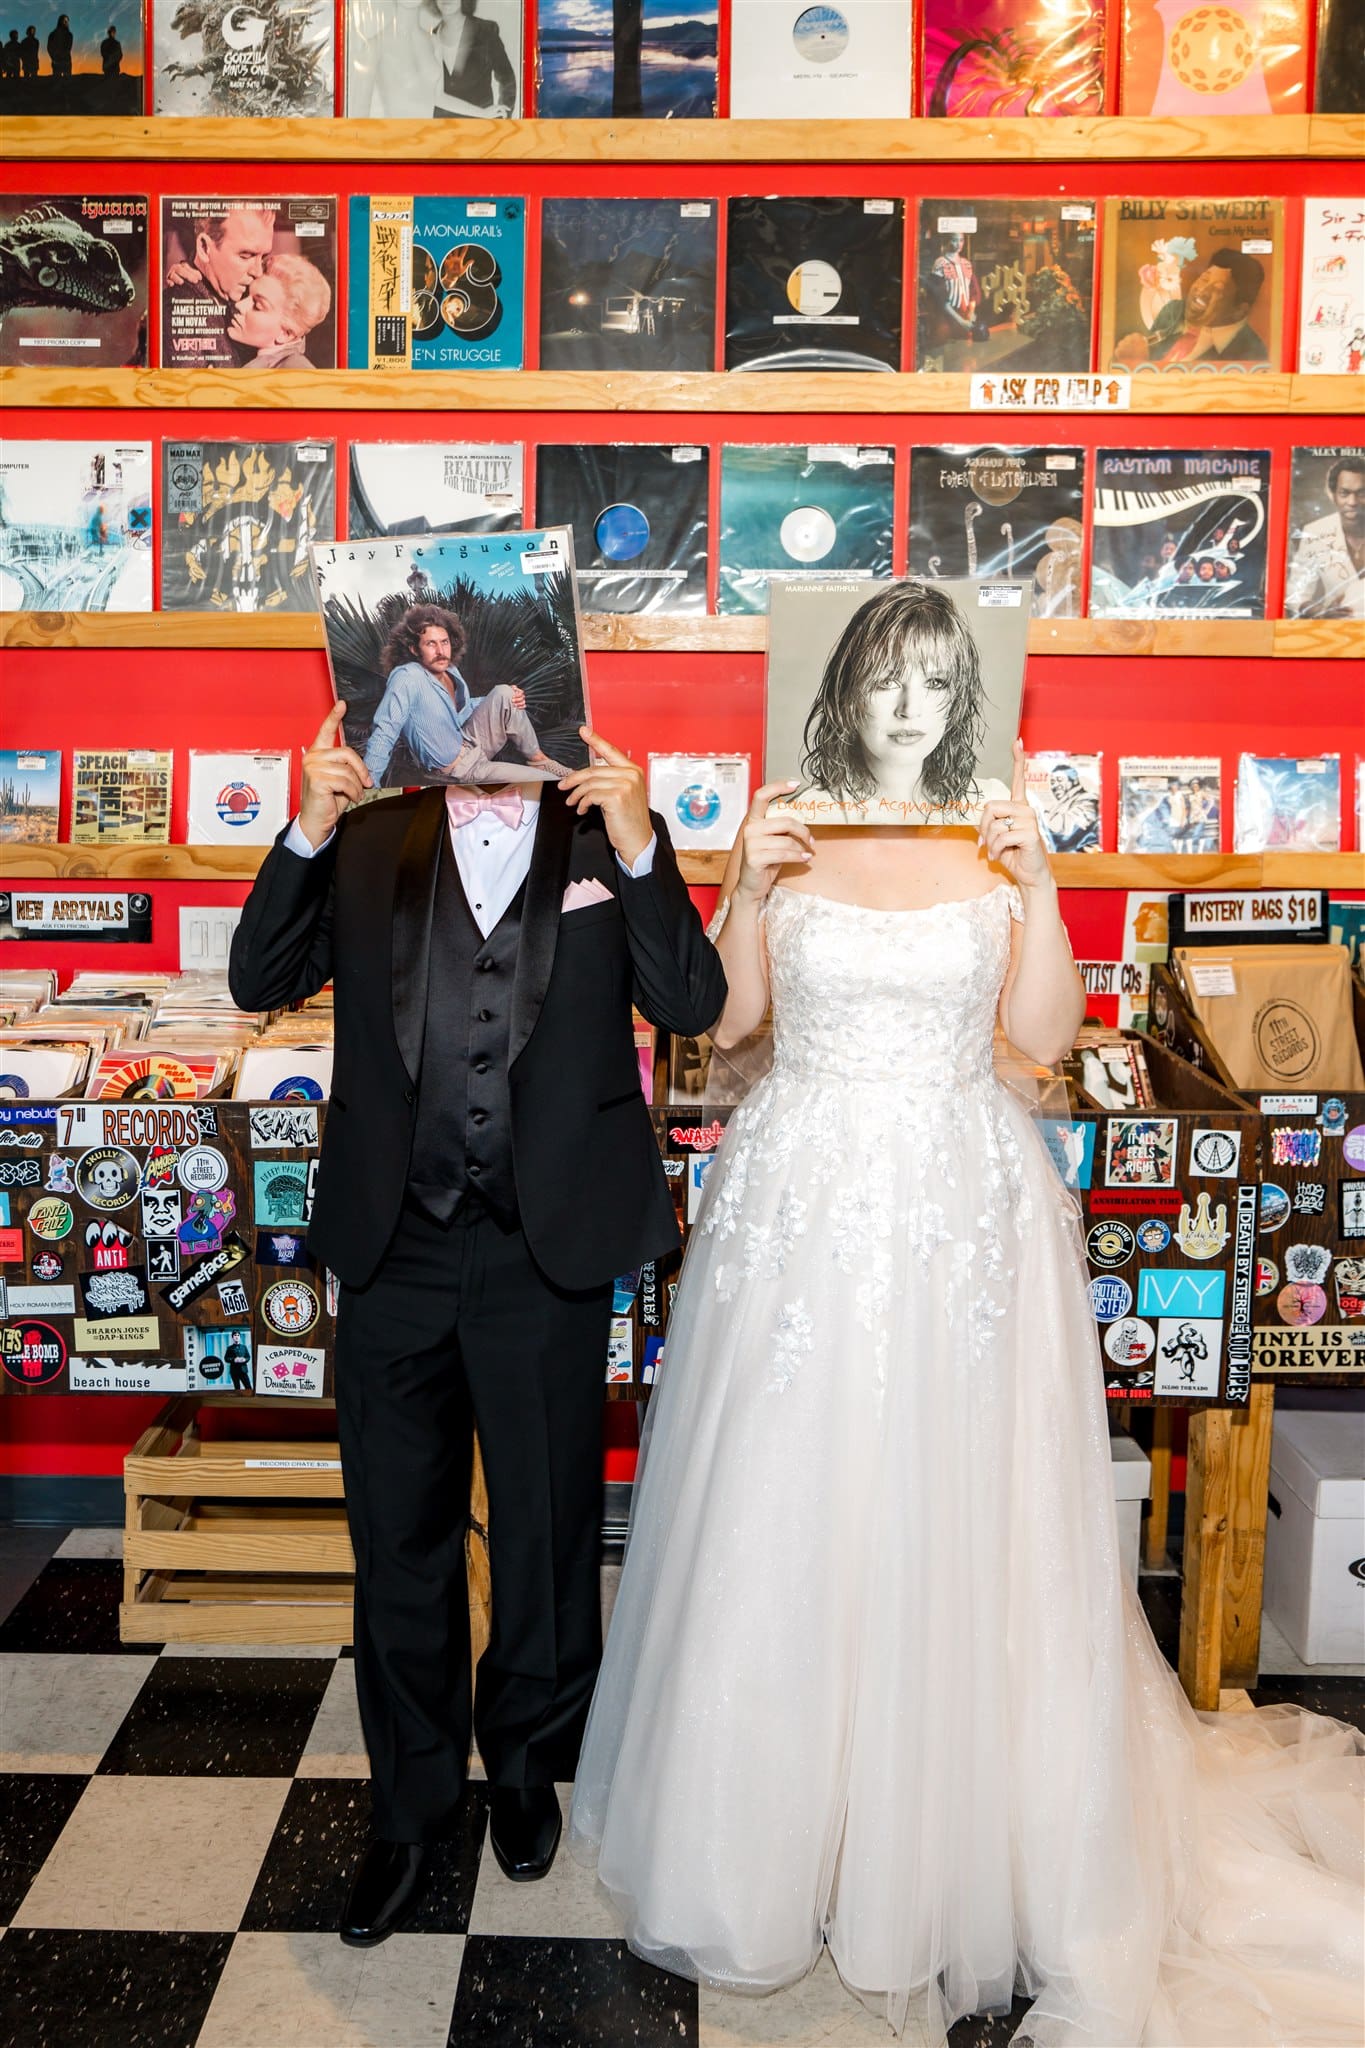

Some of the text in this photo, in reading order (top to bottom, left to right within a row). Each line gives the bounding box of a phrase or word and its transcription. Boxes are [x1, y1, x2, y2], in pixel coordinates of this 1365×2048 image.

[223, 51, 268, 65] GODZILLA
[222, 63, 270, 77] MINUS ONE
[82, 197, 147, 218] iguana
[171, 202, 188, 210] FROM
[188, 202, 199, 210] THE
[200, 202, 221, 210] MOTION
[222, 202, 244, 210] PICTURE
[1119, 200, 1169, 221] BILLY
[1320, 209, 1346, 227] Sir
[423, 224, 503, 237] MONAURAIL's
[1232, 225, 1248, 238] My
[171, 305, 227, 316] JAMES STEWART
[171, 316, 208, 327] KIM NOVAK
[172, 338, 217, 351] VERTIGO
[440, 348, 501, 362] STRUGGLE
[1000, 378, 1102, 405] ASK FOR HELP
[170, 449, 201, 457] MAD MAX
[1312, 447, 1337, 457] ALEX
[443, 460, 513, 483] REALITY
[1103, 457, 1260, 475] RHYTHM MACHINE
[443, 476, 511, 495] FOR THE PEOPLE
[939, 470, 976, 488] FOREST
[326, 538, 560, 565] Jay Ferguson
[785, 584, 860, 593] MARIANNE FAITHFULL
[78, 756, 127, 769] SPEACH
[77, 771, 168, 785] IMPEDIMENTS
[776, 798, 869, 821] Dangerous
[16, 899, 124, 921] NEW ARRIVALS
[1189, 895, 1318, 924] MYSTERY BAGS $10
[1121, 963, 1143, 994] CDs
[1269, 1027, 1300, 1052] STREET
[1271, 1037, 1309, 1067] RECORDS
[60, 1107, 200, 1146] 7" RECORDS
[1127, 1132, 1156, 1145] IT ALL
[85, 1150, 128, 1168] SKULLY'Z
[1127, 1146, 1156, 1159] FEELS
[145, 1153, 180, 1182] AMOEBA
[192, 1166, 213, 1174] STREET
[196, 1158, 210, 1167] 11TH
[1126, 1160, 1156, 1174] RIGHT
[190, 1173, 217, 1181] RECORDS
[90, 1192, 132, 1207] RECORDZ
[31, 1204, 69, 1220] SANTA
[36, 1217, 68, 1233] CRUZ
[1093, 1223, 1132, 1243] BAD TIMING
[1155, 1222, 1168, 1233] BOY
[96, 1250, 126, 1267] ANTI-
[1234, 1212, 1253, 1324] DEATH BY STEREO
[168, 1251, 230, 1308] gameface
[1091, 1283, 1128, 1299] BROTHER
[1143, 1275, 1220, 1311] IVY
[86, 1326, 150, 1335] SHARON JONES
[1252, 1331, 1343, 1347] VINYL IS
[32, 1343, 59, 1359] BOMB
[269, 1349, 303, 1360] CRAPPED
[302, 1353, 318, 1364] OUT
[1251, 1349, 1365, 1367] FOREVER
[1226, 1324, 1250, 1401] THE LOUD PIPES
[74, 1376, 151, 1388] beach house
[264, 1376, 316, 1391] Downtown Tattoo
